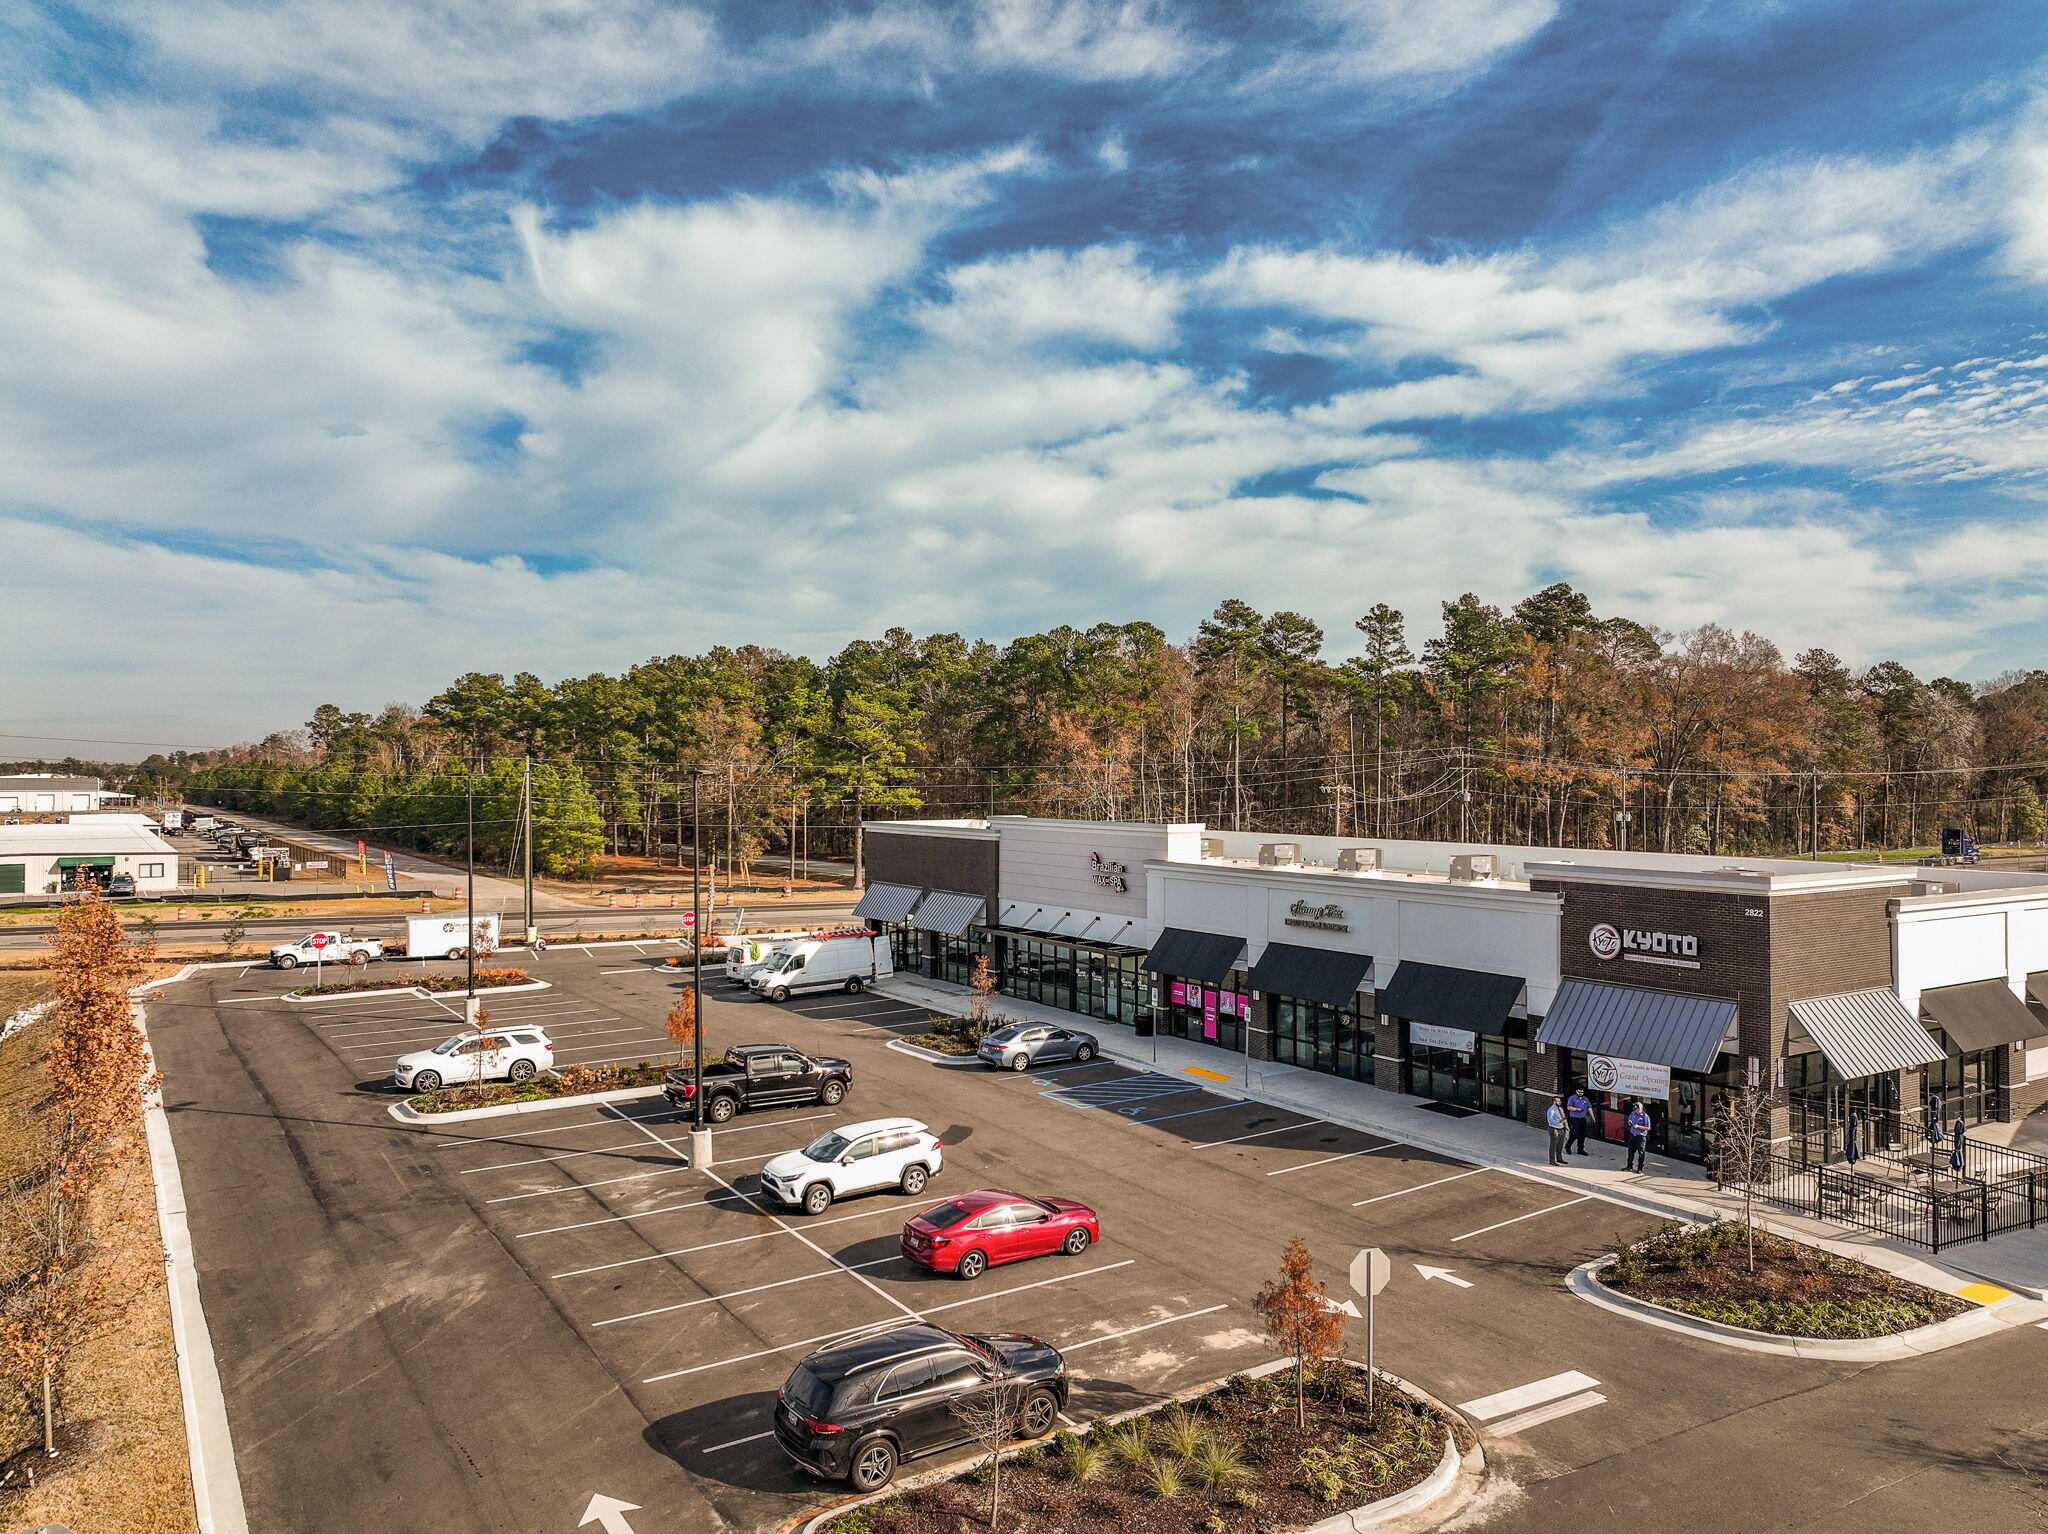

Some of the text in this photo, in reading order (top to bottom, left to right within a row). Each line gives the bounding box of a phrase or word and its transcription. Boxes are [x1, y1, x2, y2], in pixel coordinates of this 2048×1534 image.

[1092, 861, 1123, 873] Brazilian
[1109, 876, 1122, 887] SPA
[1744, 908, 1764, 917] 2822
[1623, 929, 1698, 956] KYOTO
[1619, 1072, 1670, 1087] Grand Opening
